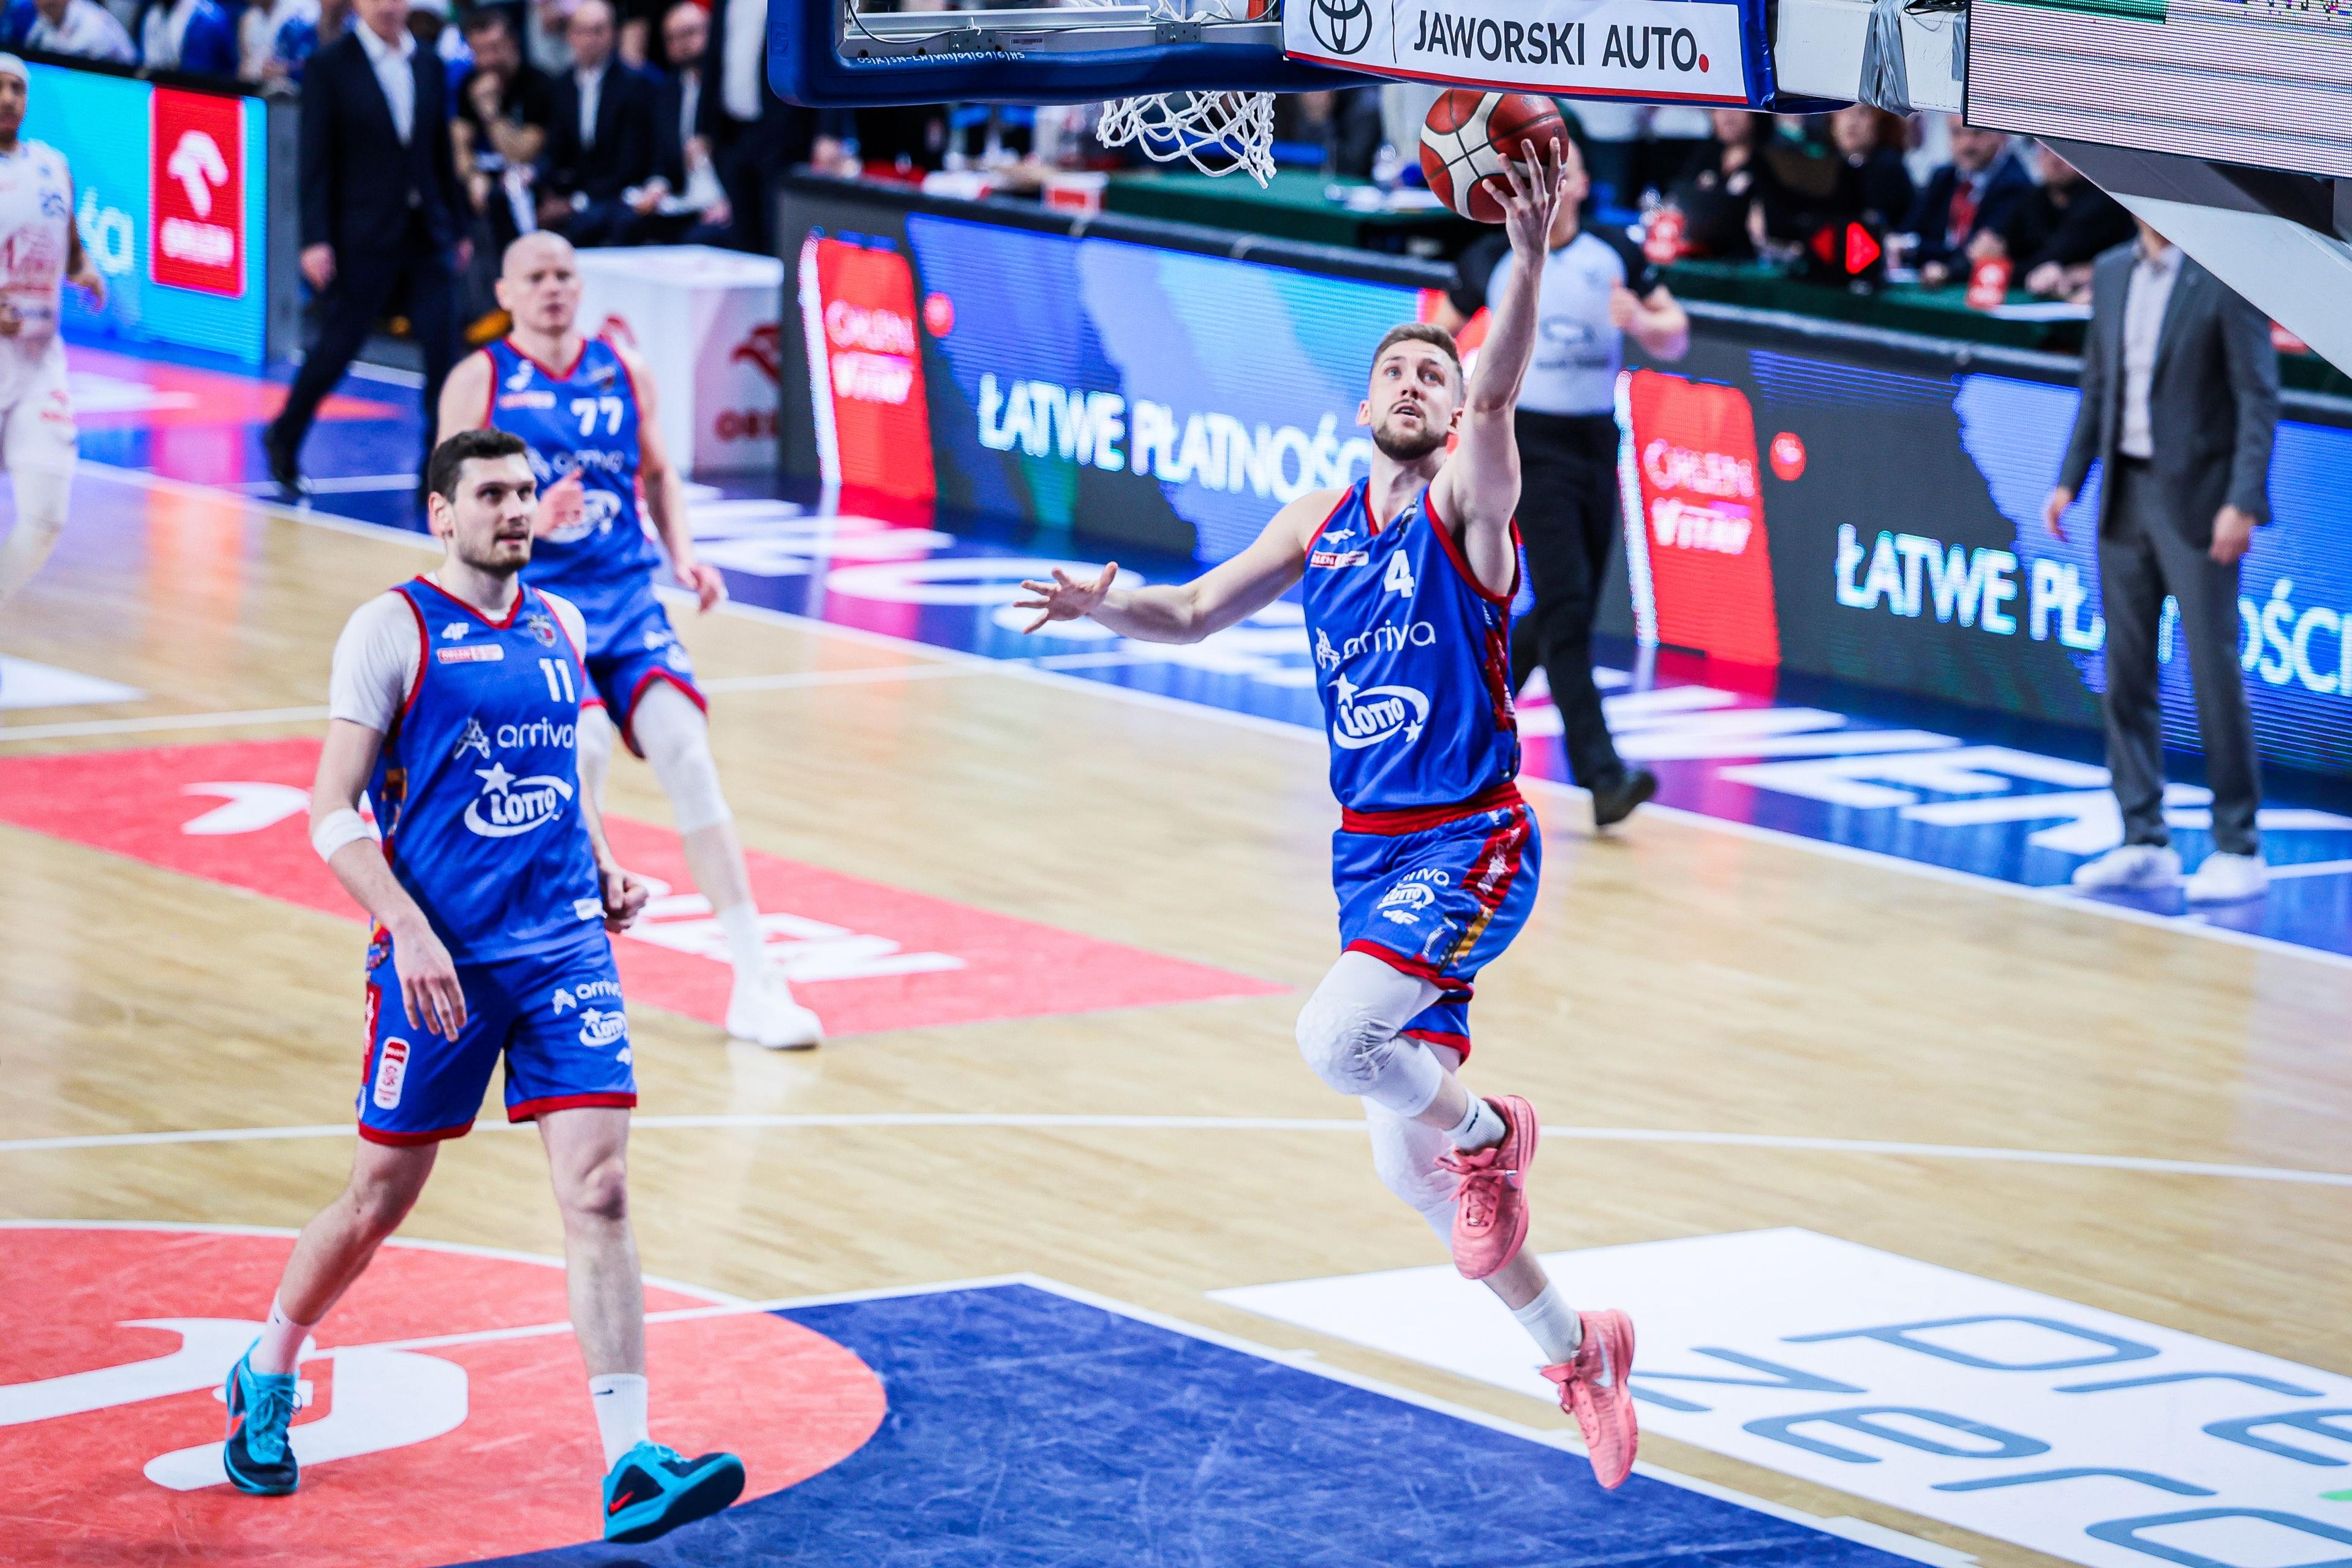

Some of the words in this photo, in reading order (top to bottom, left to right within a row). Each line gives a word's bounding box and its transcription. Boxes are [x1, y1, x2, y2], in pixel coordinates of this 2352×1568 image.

[1414, 9, 1585, 66] JAWORSKI
[1601, 24, 1709, 74] AUTO.
[570, 396, 624, 437] 77
[978, 372, 1126, 472] ŁATWE
[1131, 399, 1374, 503] PŁATNOŚC
[1383, 549, 1415, 598] 4
[1836, 522, 2018, 635] ŁATWE
[1343, 619, 1436, 660] arriva
[538, 657, 576, 704] 11
[1340, 697, 1406, 737] LOTTO
[490, 786, 557, 824] LOTTO
